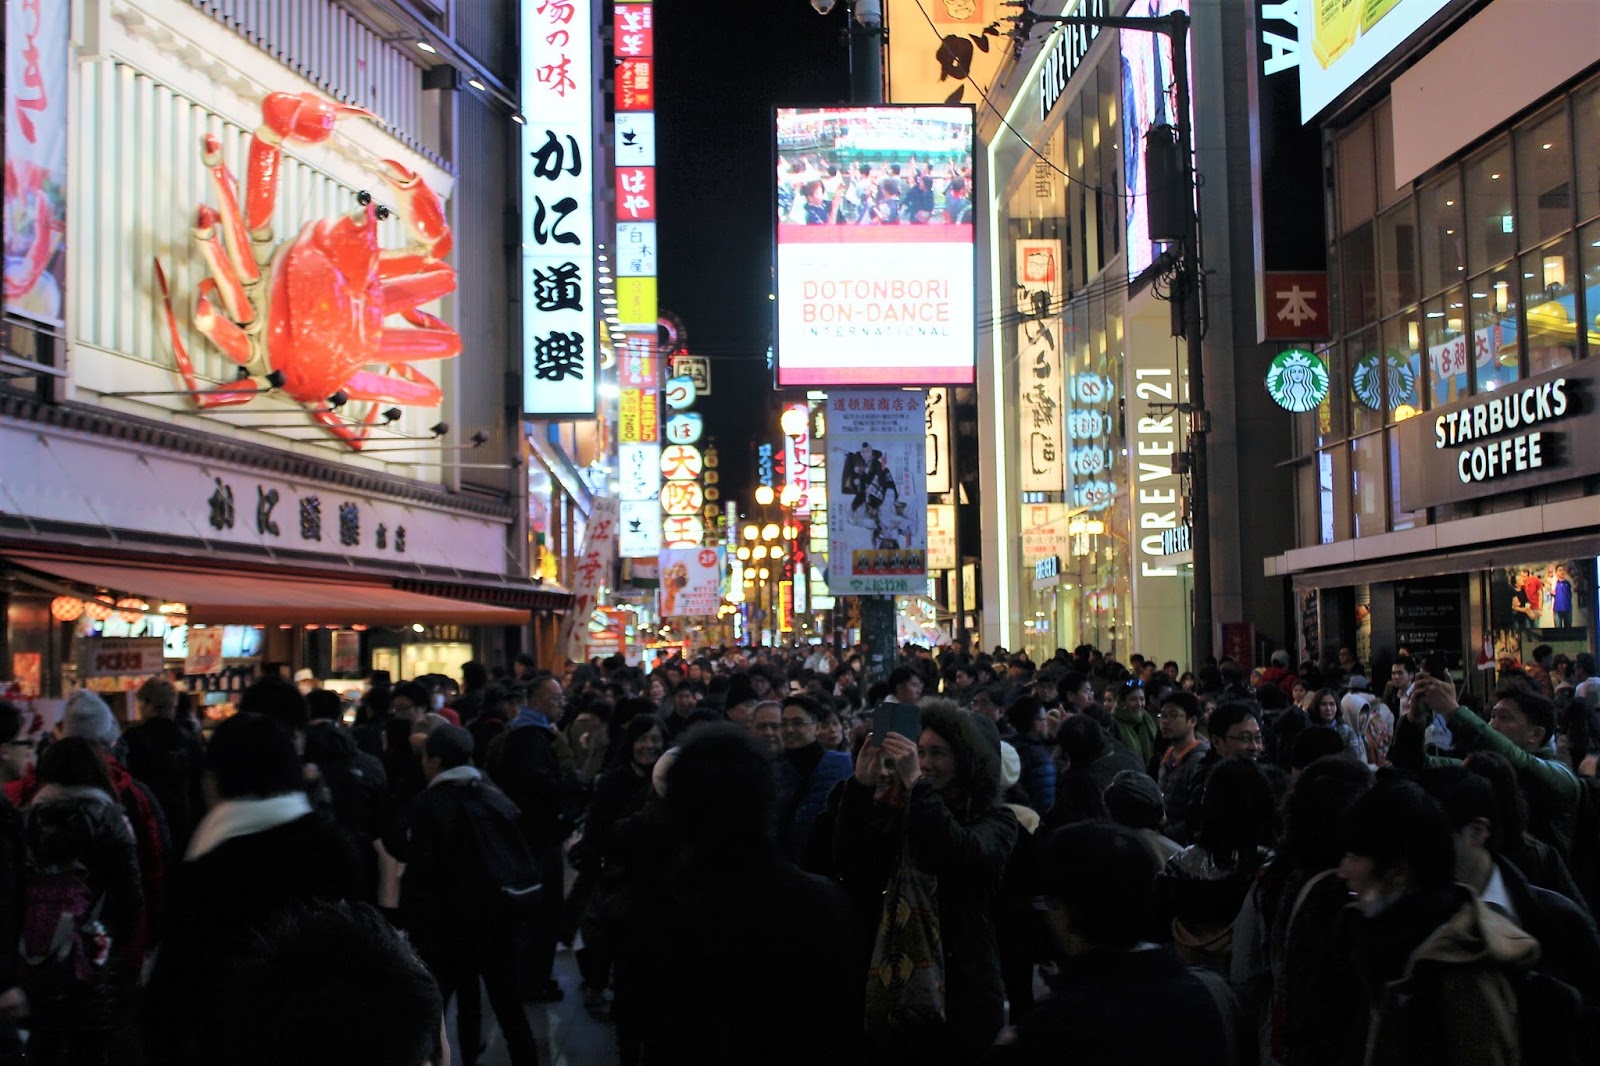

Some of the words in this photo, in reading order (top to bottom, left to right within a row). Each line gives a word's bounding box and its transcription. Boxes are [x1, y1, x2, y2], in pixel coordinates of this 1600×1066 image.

[630, 227, 652, 272] 白木屋
[803, 280, 949, 299] DOTONBORI
[1276, 285, 1318, 327] 本
[801, 326, 950, 337] INTERNATIONAL
[802, 302, 950, 322] BON-DANCE
[1136, 368, 1172, 400] 21
[1435, 378, 1567, 449] STARBUCKS
[1458, 433, 1542, 484] COFFEE
[1138, 416, 1178, 577] FOREVER
